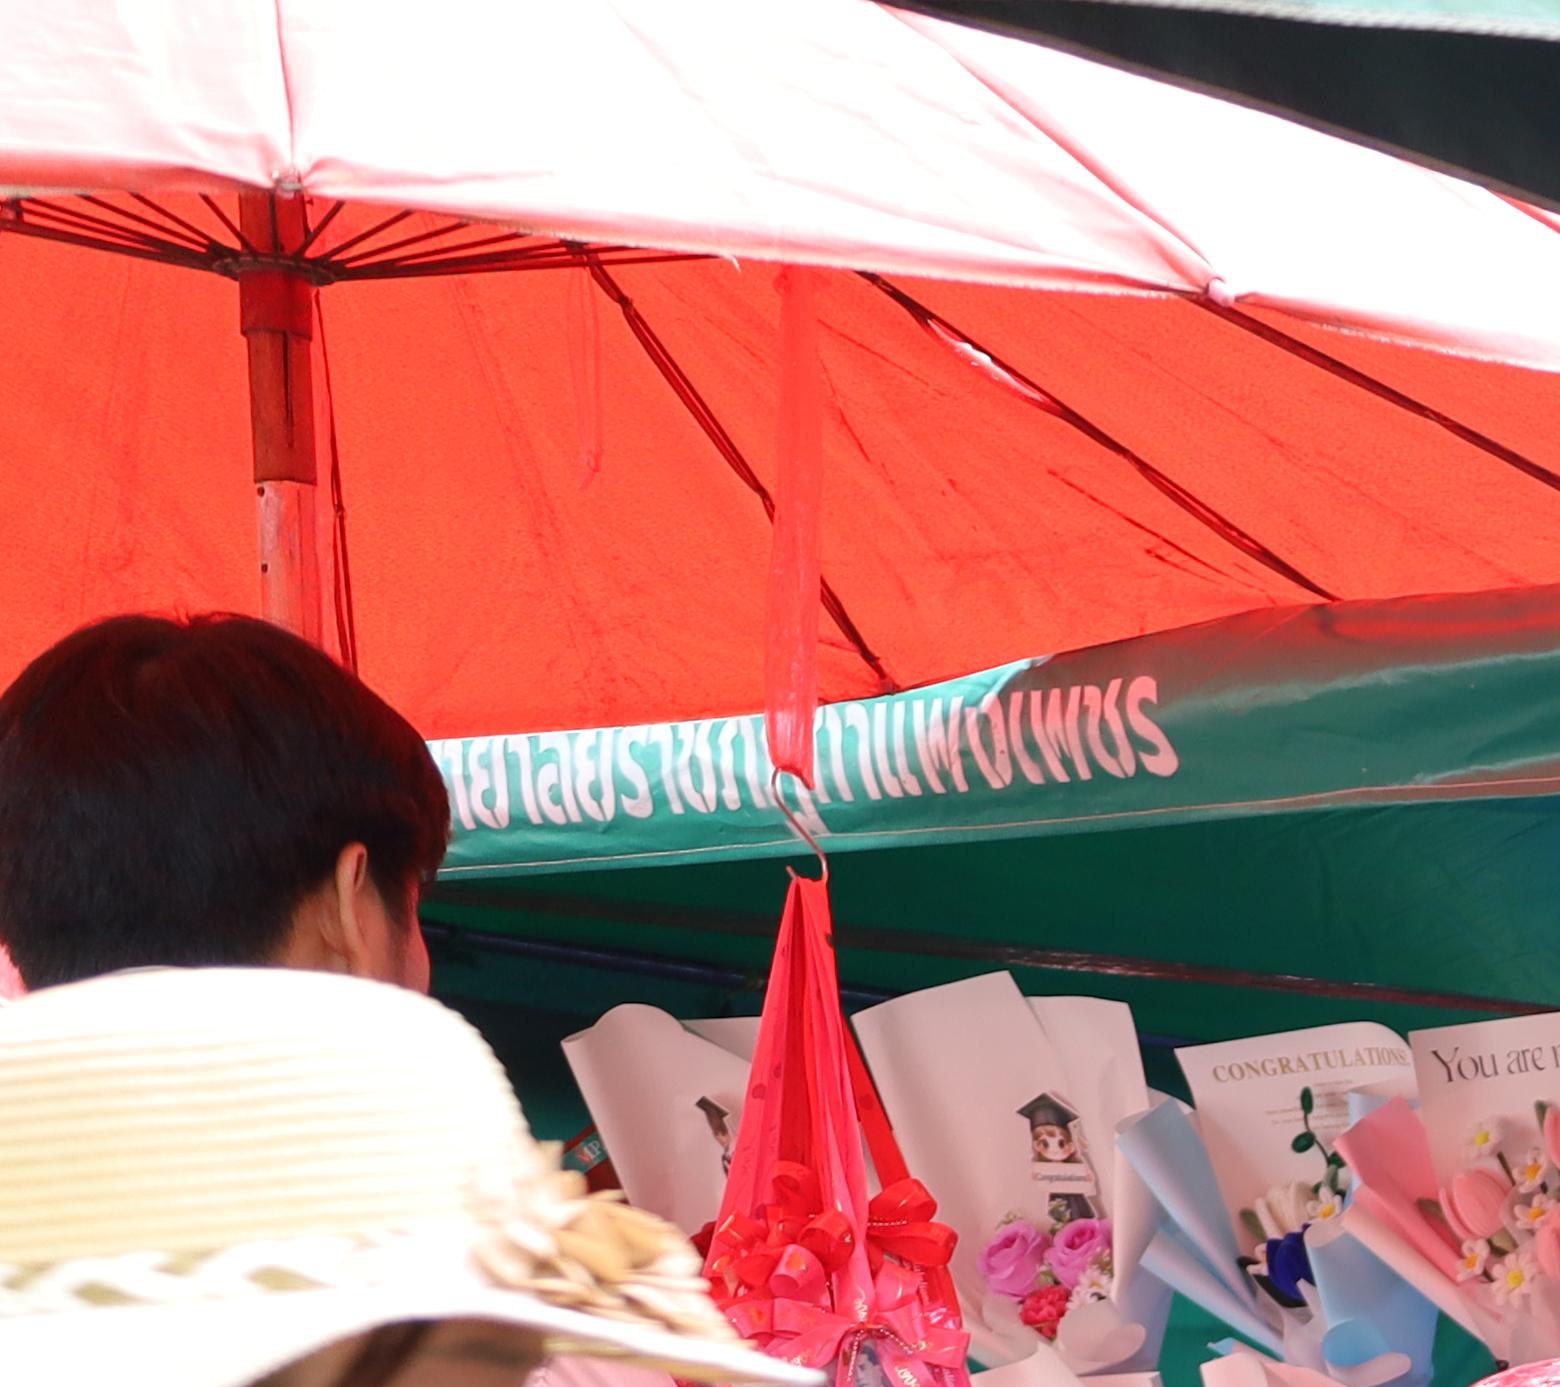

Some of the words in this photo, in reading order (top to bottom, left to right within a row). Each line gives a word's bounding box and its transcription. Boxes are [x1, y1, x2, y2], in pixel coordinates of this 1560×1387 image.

[1212, 1046, 1409, 1083] CONGRATULATIONS
[1432, 1048, 1498, 1083] You
[1507, 1045, 1544, 1074] are
